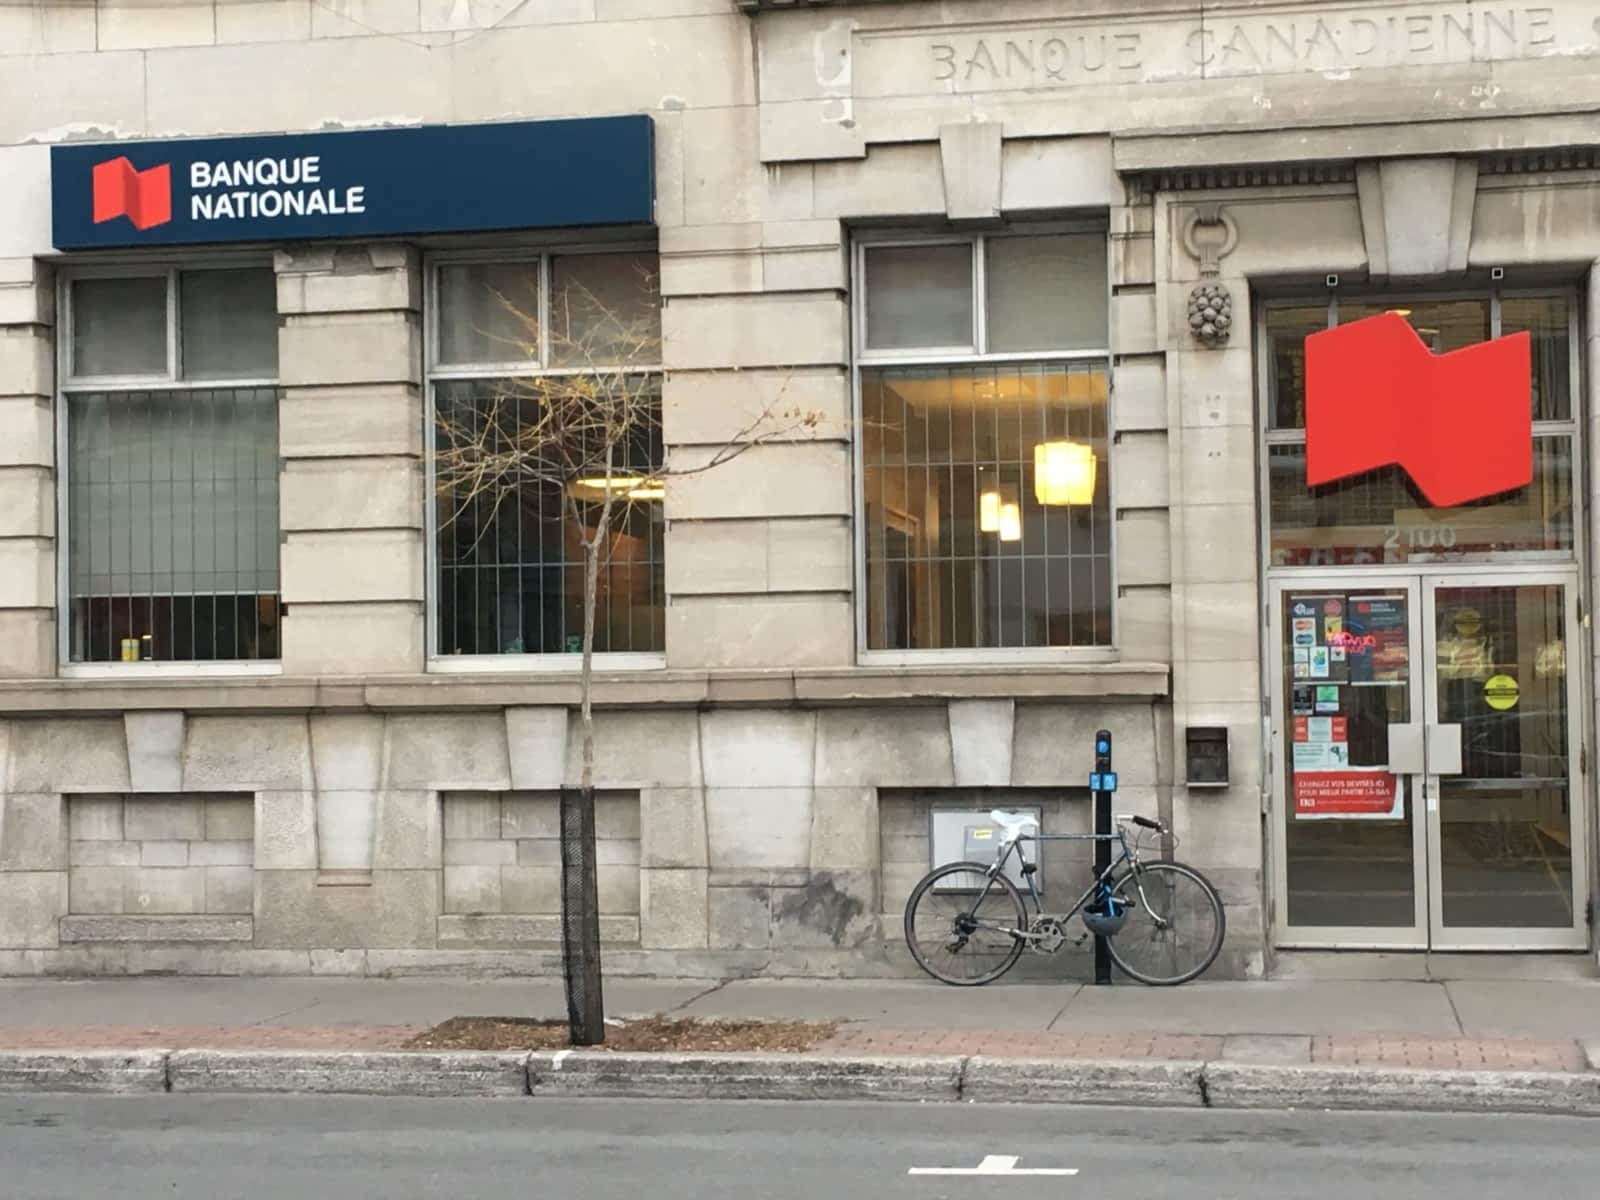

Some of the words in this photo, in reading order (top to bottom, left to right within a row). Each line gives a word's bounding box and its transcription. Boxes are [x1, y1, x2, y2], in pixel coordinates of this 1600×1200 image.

[931, 32, 1142, 81] BANQUE
[1186, 7, 1556, 66] CANADIENNE
[190, 155, 321, 189] BANQUE
[190, 185, 366, 220] NATIONALE
[1383, 525, 1457, 550] 2100
